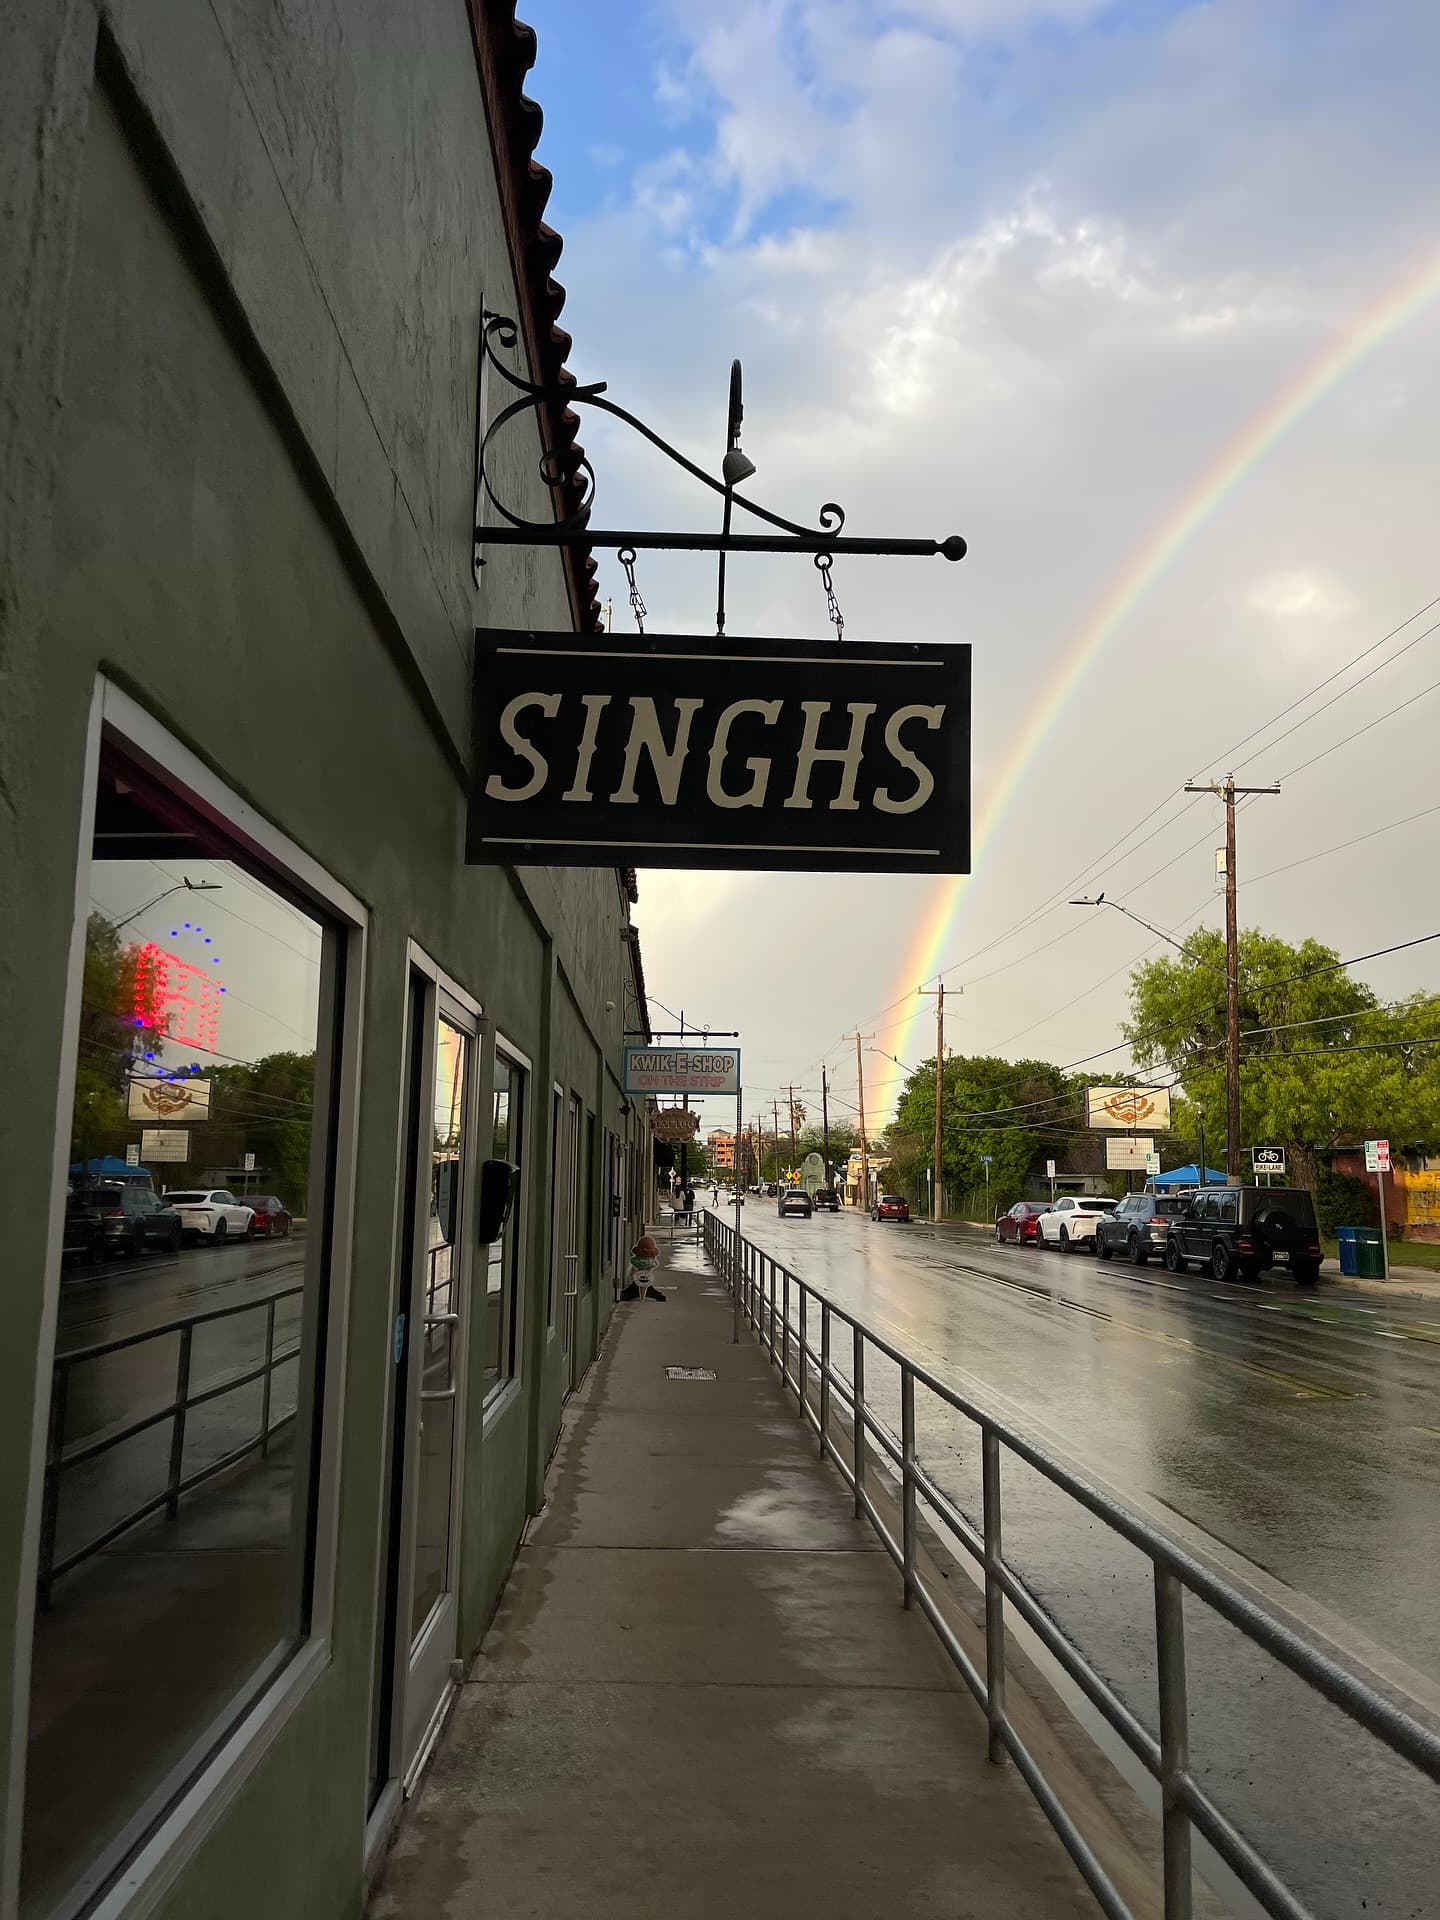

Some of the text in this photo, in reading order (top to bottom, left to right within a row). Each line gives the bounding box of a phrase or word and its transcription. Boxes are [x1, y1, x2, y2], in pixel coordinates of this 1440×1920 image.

[484, 691, 947, 815] SINGHS
[630, 1053, 734, 1073] KWIK-E-SHOP
[639, 1075, 726, 1087] ON THE STRIP
[655, 1119, 695, 1129] TATTOO
